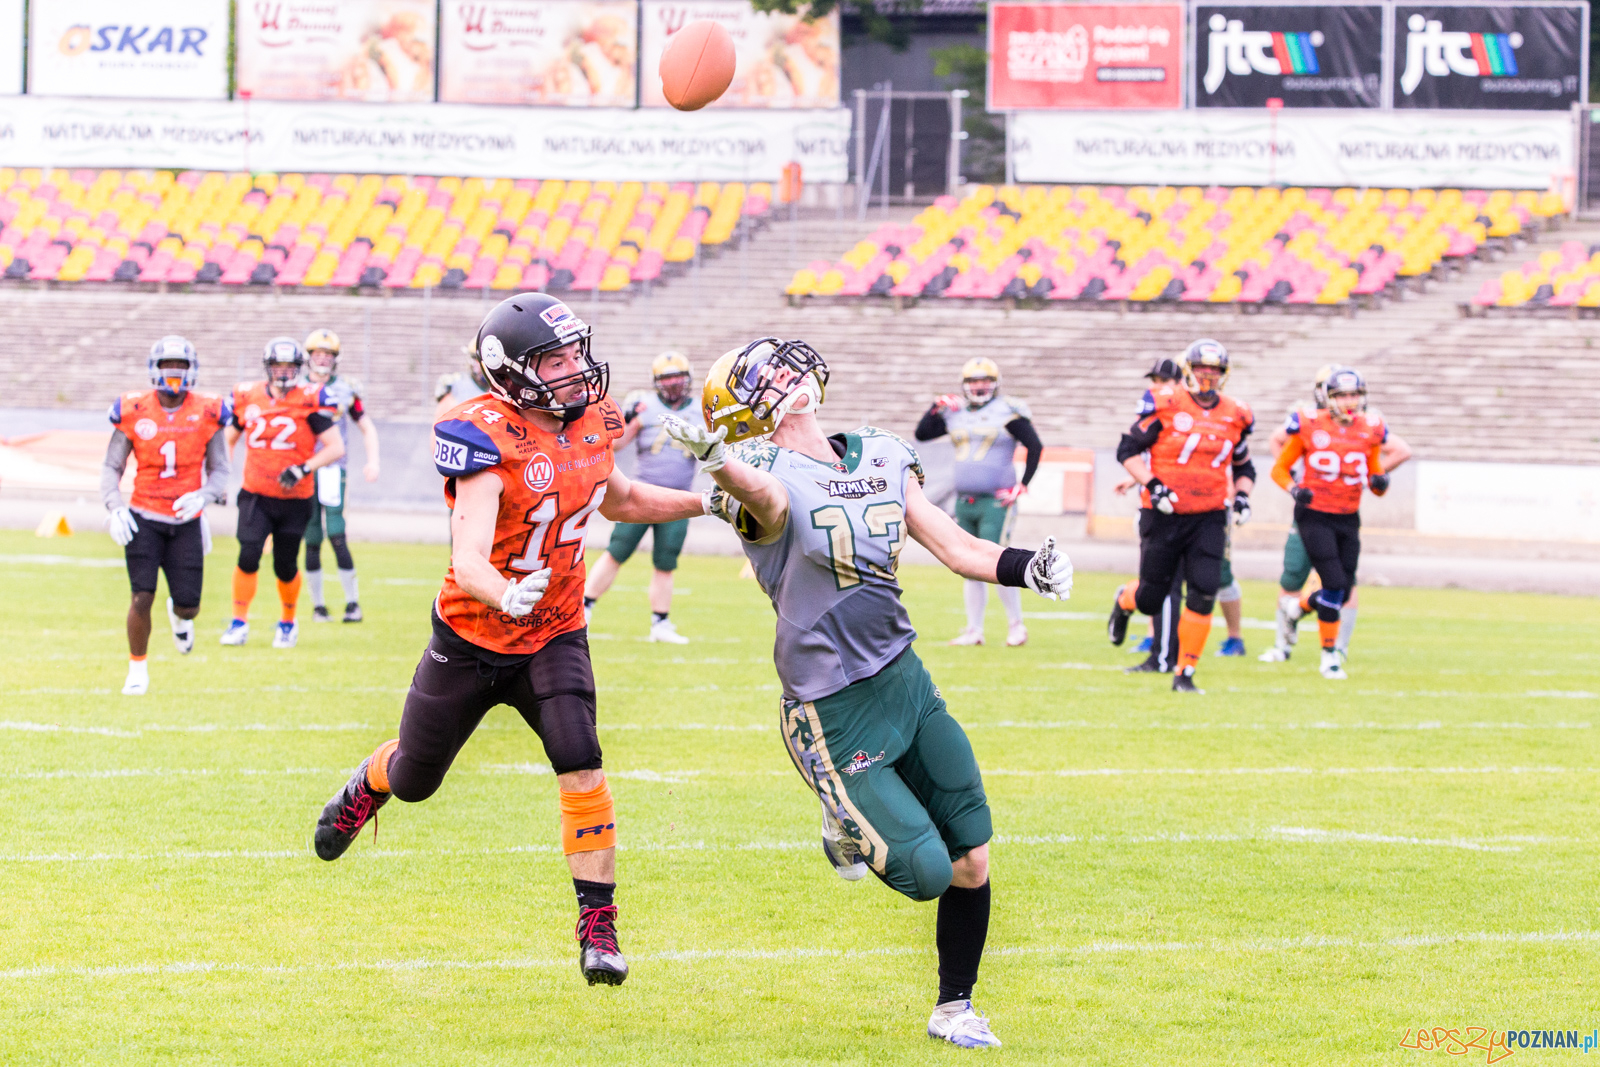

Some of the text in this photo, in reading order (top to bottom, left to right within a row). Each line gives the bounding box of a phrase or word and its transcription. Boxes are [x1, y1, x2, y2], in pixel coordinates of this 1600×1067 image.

[58, 24, 208, 57] OSKAR
[43, 123, 153, 141] NATURALNA
[292, 127, 406, 147] NATURALNA
[543, 135, 655, 156] NATURALNA
[1076, 138, 1186, 158] NATURALNA
[1340, 140, 1449, 160] NATURALNA
[463, 403, 505, 425] 14
[248, 416, 298, 450] 22
[159, 440, 177, 479] 1
[473, 450, 499, 461] GROUP
[556, 451, 606, 473] WENGLORZ
[1308, 450, 1369, 486] 93
[830, 480, 875, 496] ARMIA
[506, 479, 608, 574] 14
[810, 500, 908, 592] 13
